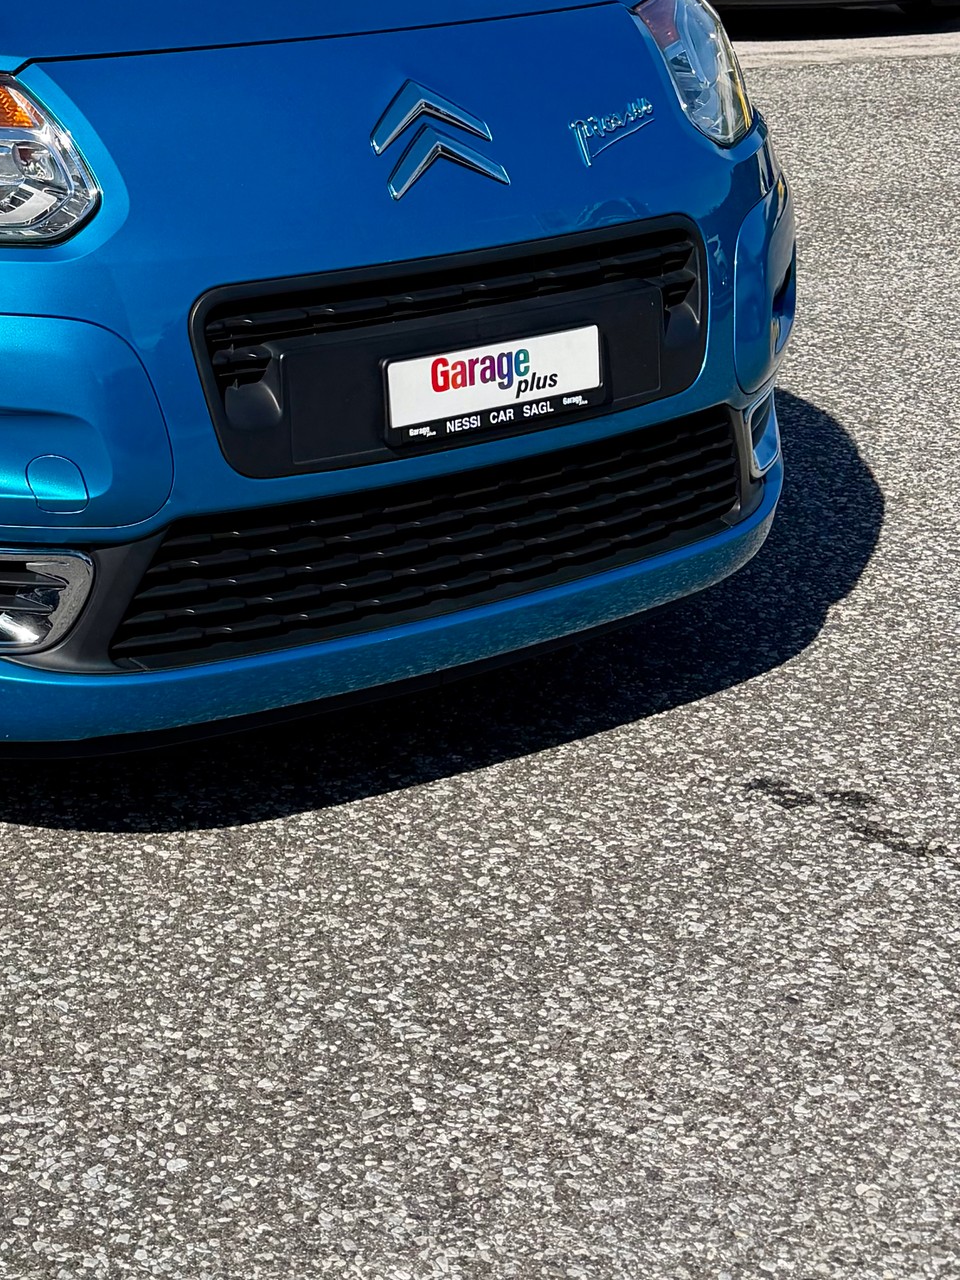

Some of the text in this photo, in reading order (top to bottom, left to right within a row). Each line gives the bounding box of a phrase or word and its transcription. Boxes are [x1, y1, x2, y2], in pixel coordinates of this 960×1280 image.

[431, 348, 531, 393] Garage
[515, 372, 558, 399] plus
[446, 401, 554, 434] NESSI CAR SAGL
